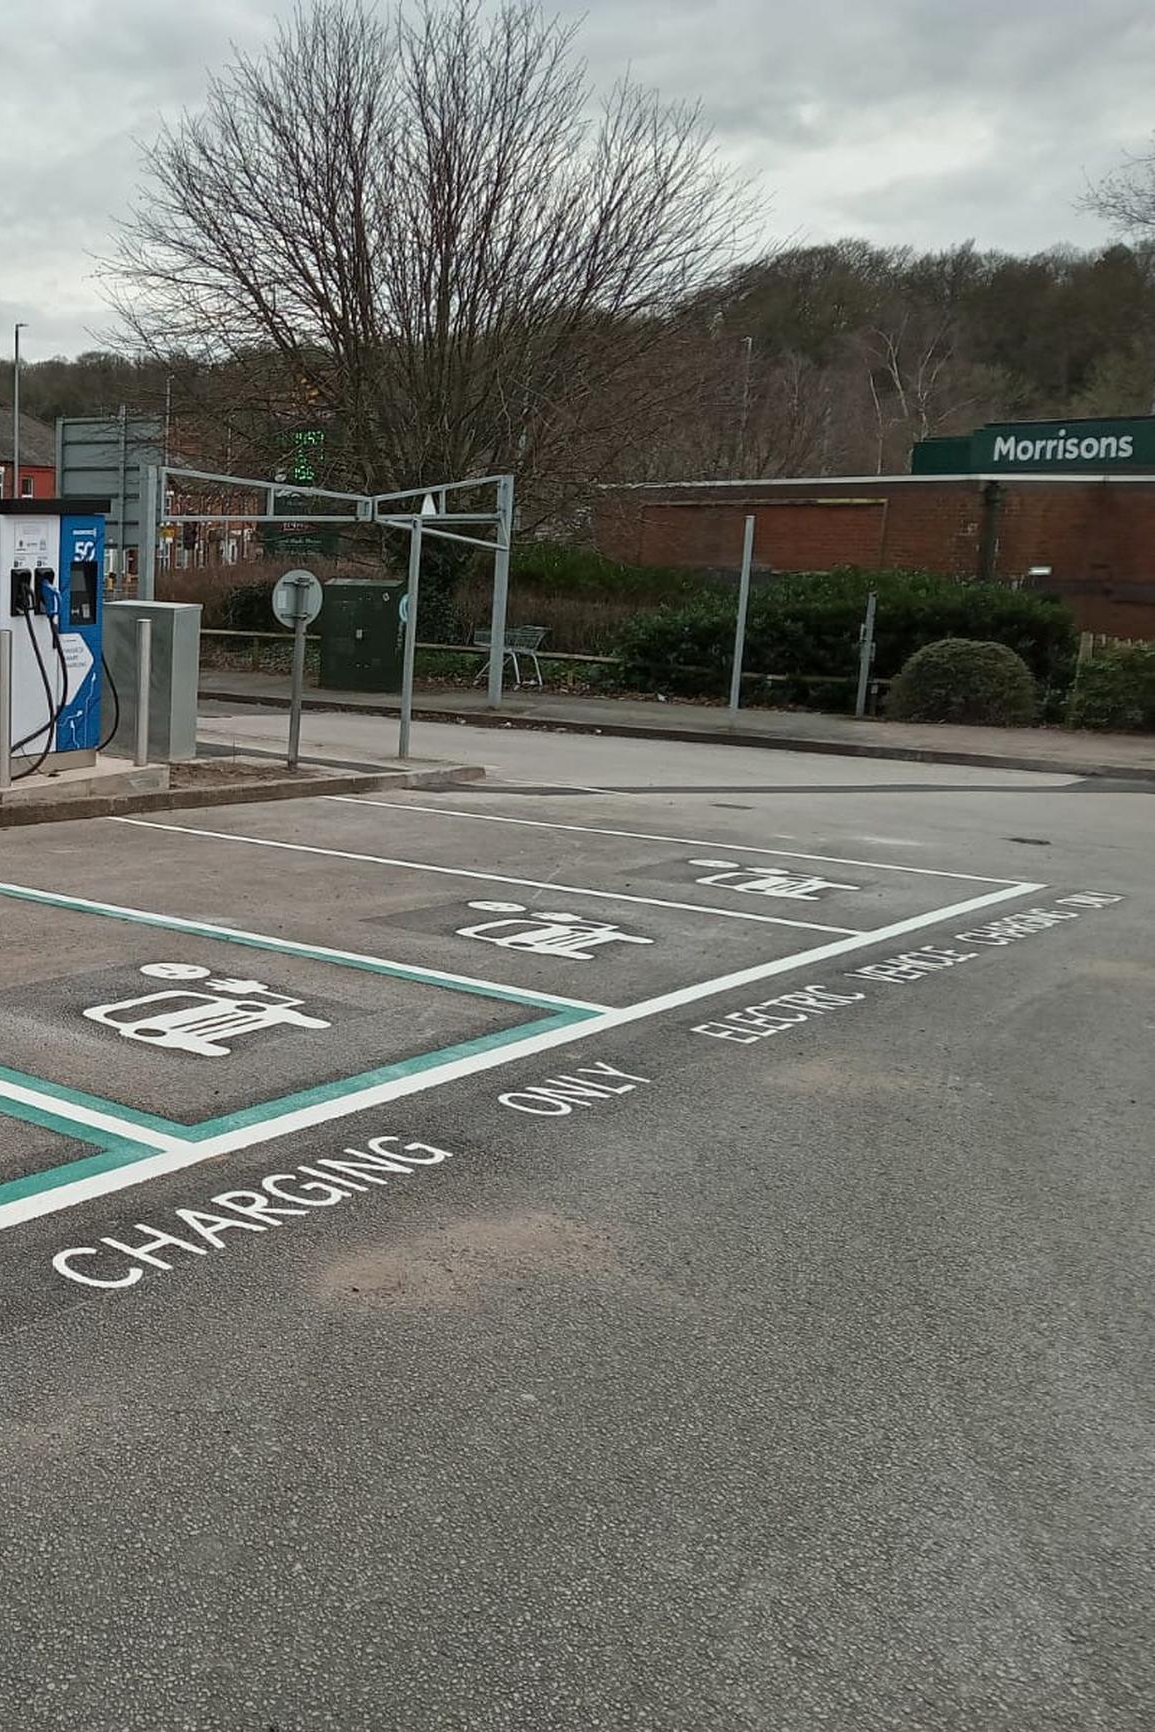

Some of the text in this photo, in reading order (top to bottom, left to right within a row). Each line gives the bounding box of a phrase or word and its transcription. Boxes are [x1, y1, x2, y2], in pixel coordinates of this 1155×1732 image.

[993, 429, 1133, 461] Morrisons
[689, 984, 866, 1044] ELECTRIC
[844, 945, 980, 983] VEHICLE
[955, 908, 1080, 945] CHARGING
[52, 1135, 454, 1290] CHARGING
[497, 1061, 652, 1117] ONLY
